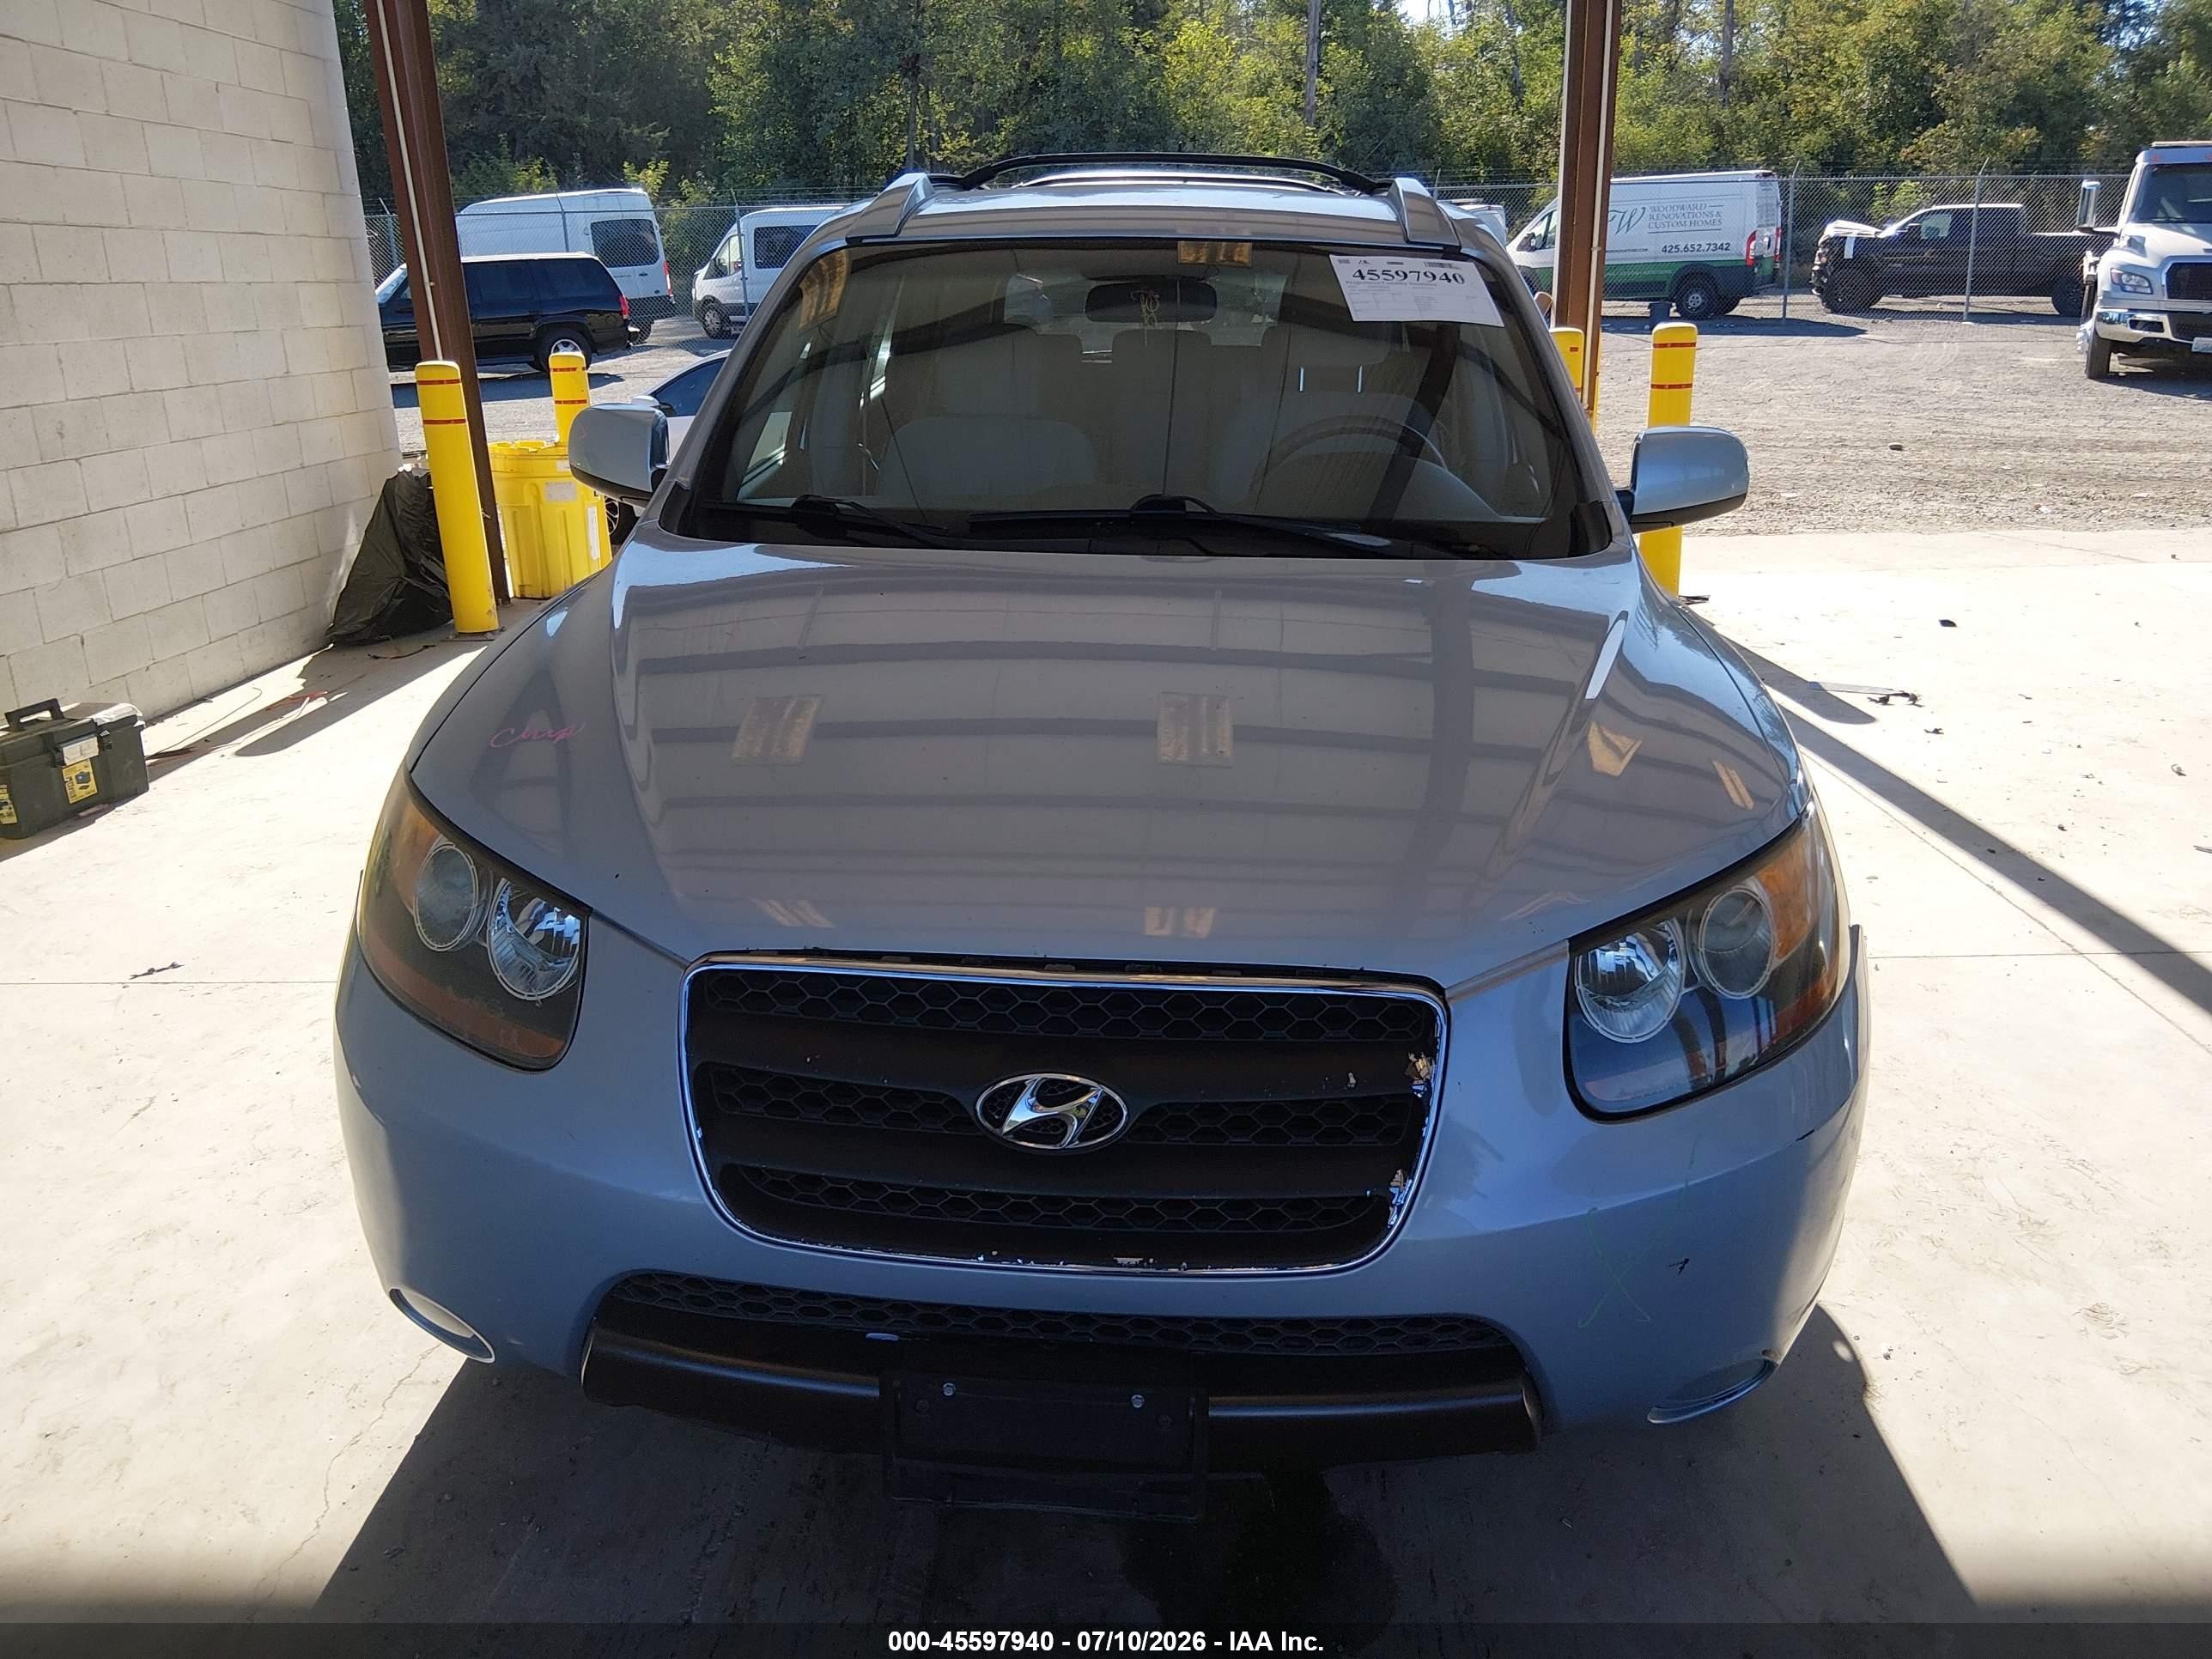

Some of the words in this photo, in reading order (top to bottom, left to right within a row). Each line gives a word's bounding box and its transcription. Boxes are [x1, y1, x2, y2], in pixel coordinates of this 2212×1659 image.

[1649, 203, 1708, 214] WOODWARD
[1648, 221, 1687, 229] CUSTOM
[1689, 218, 1723, 228] HOMES
[1661, 242, 1731, 254] 425.652.7342
[1352, 269, 1465, 285] 45597940
